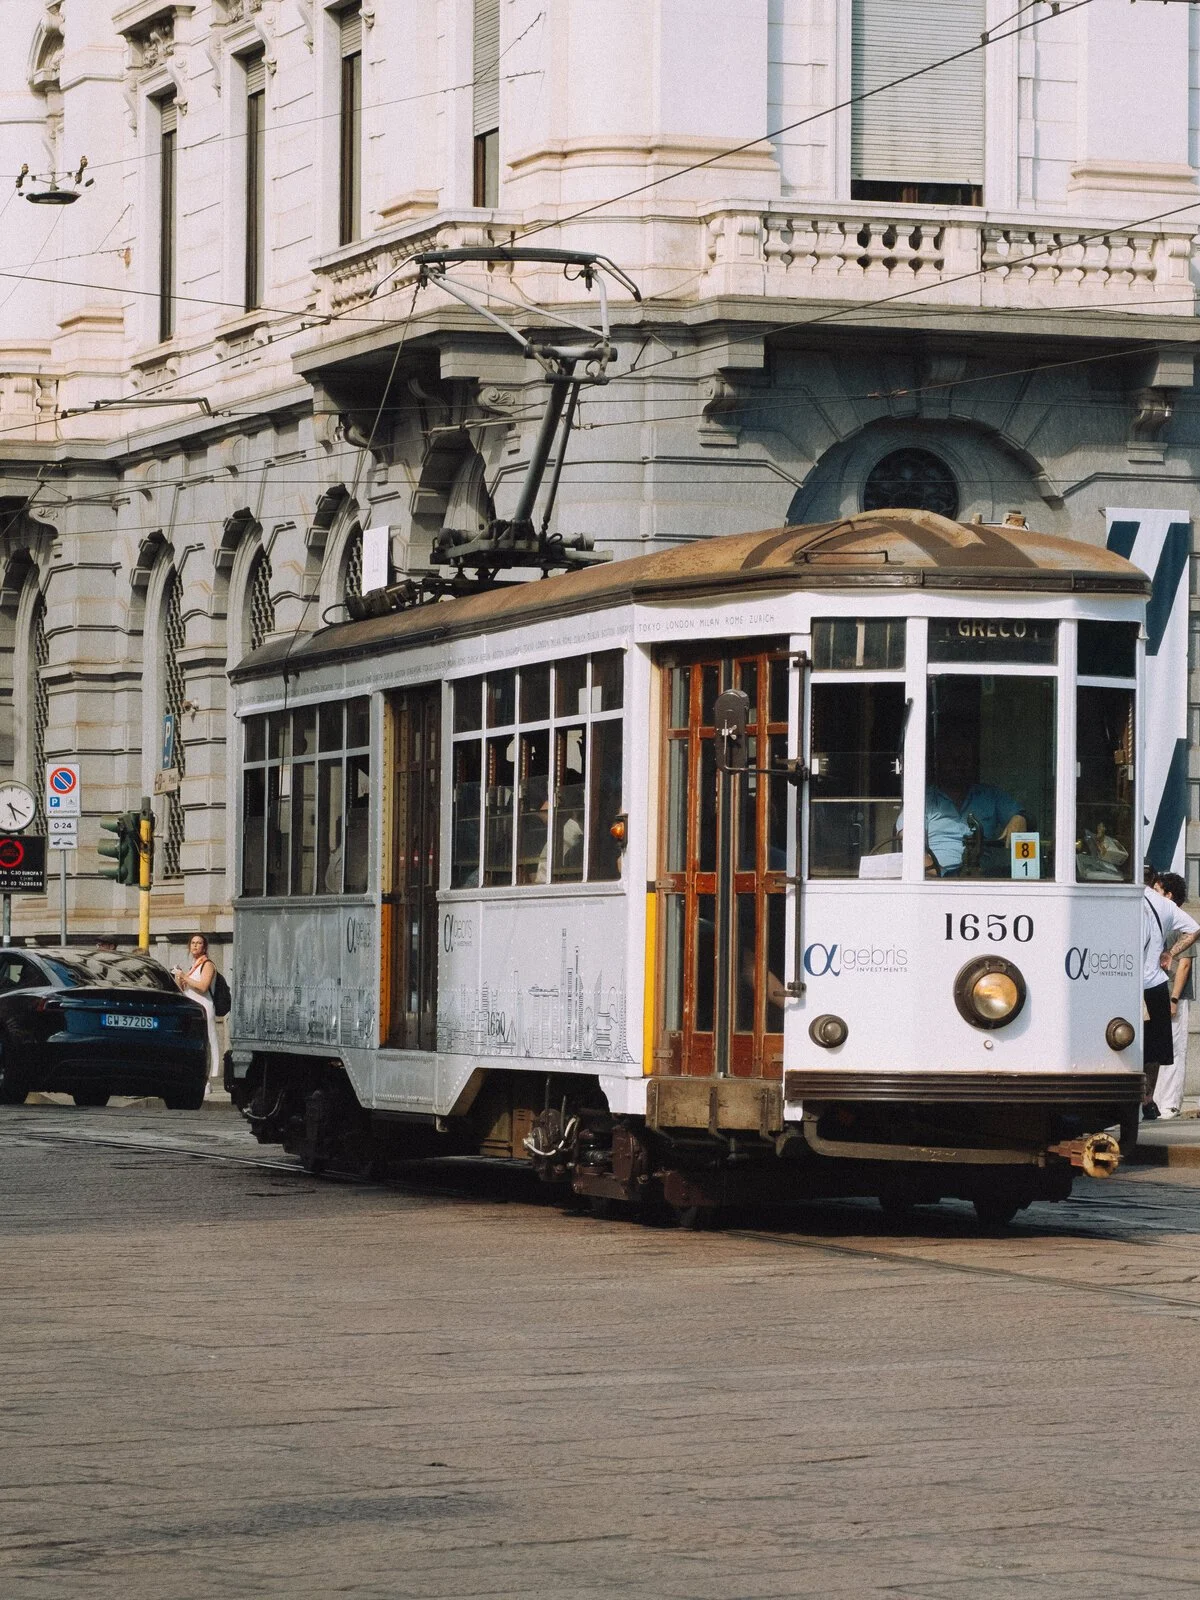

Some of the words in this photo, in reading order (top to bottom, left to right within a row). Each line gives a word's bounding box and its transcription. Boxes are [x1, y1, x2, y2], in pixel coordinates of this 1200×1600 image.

[638, 623, 660, 632] TOKYO
[666, 620, 694, 630] LONDON
[700, 618, 720, 628] MILAN
[726, 616, 744, 625] ROME
[750, 614, 774, 624] ZURICH
[958, 618, 1027, 638] GRECO
[51, 798, 58, 806] P
[1022, 842, 1029, 858] 8
[1022, 861, 1028, 876] 1
[944, 912, 1034, 943] 1650
